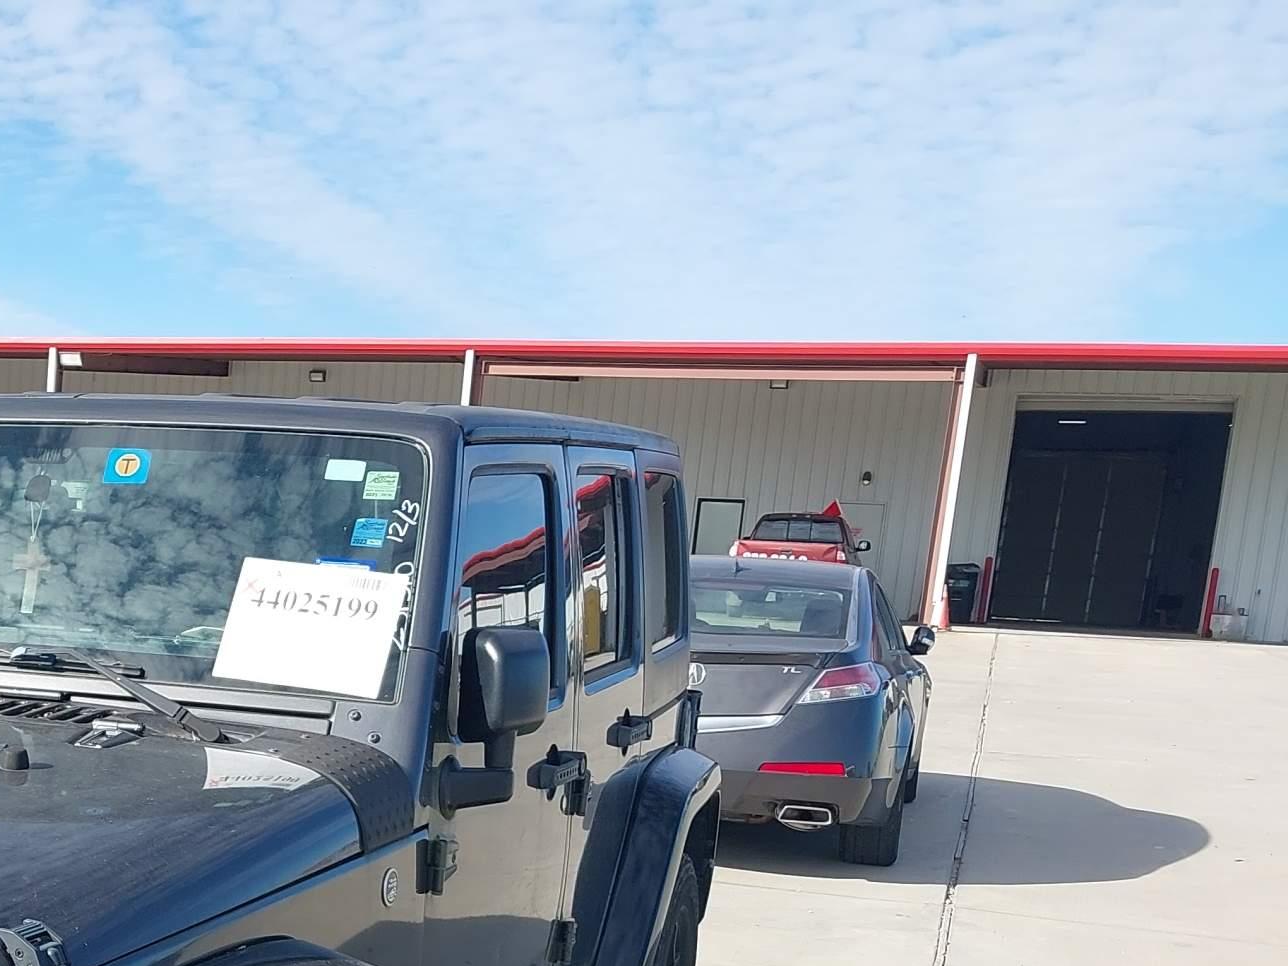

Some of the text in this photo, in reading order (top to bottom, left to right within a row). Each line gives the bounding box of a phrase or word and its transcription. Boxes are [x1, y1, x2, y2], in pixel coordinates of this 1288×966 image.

[121, 458, 137, 475] T
[250, 586, 380, 621] 44025199
[781, 666, 801, 674] TL
